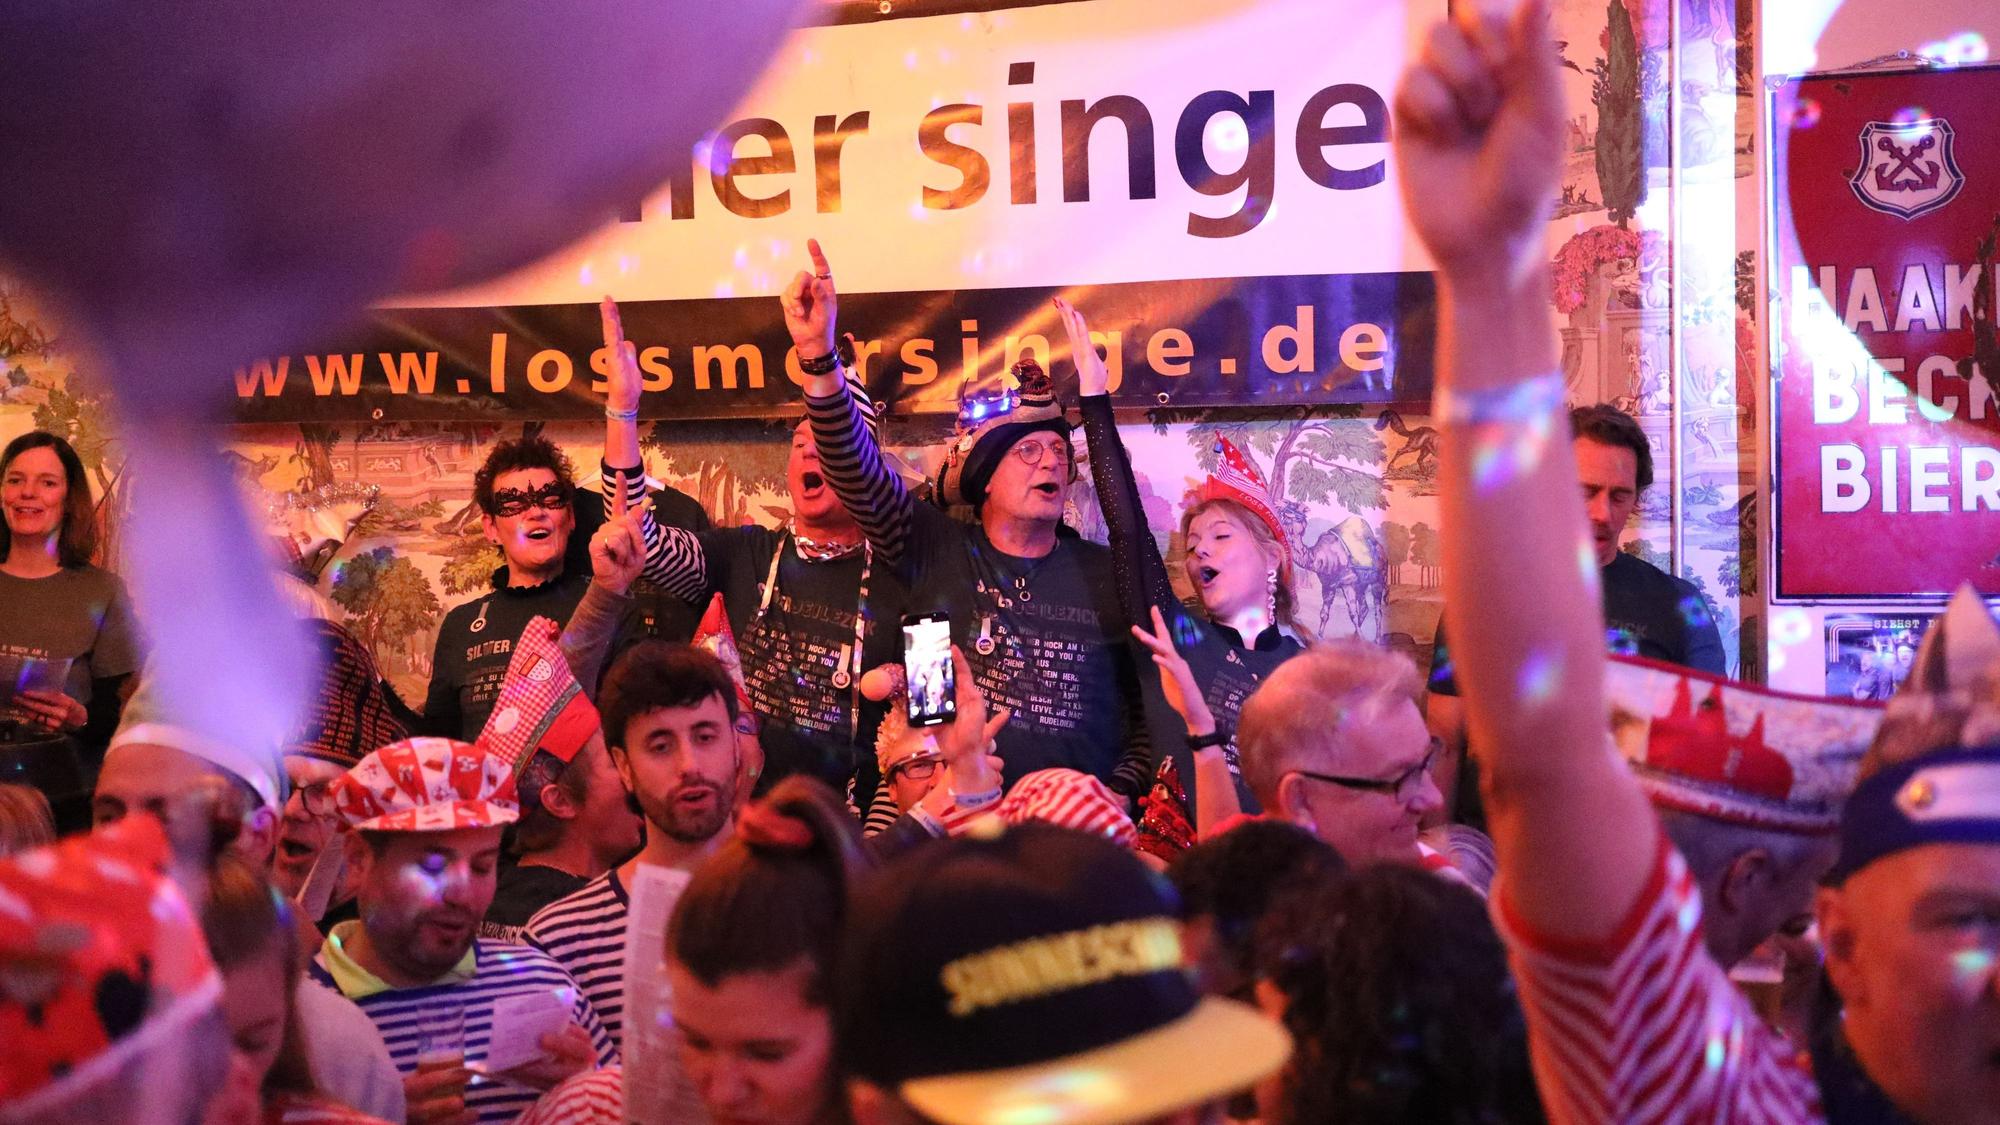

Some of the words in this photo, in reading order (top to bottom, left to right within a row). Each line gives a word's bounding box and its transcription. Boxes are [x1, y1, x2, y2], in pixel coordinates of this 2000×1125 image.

[618, 110, 871, 223] er
[918, 61, 1391, 238] singe
[1791, 263, 2000, 333] HAAK
[1820, 444, 2000, 513] BIER
[1058, 652, 1074, 661] YOU
[1873, 619, 1920, 629] SIEHST
